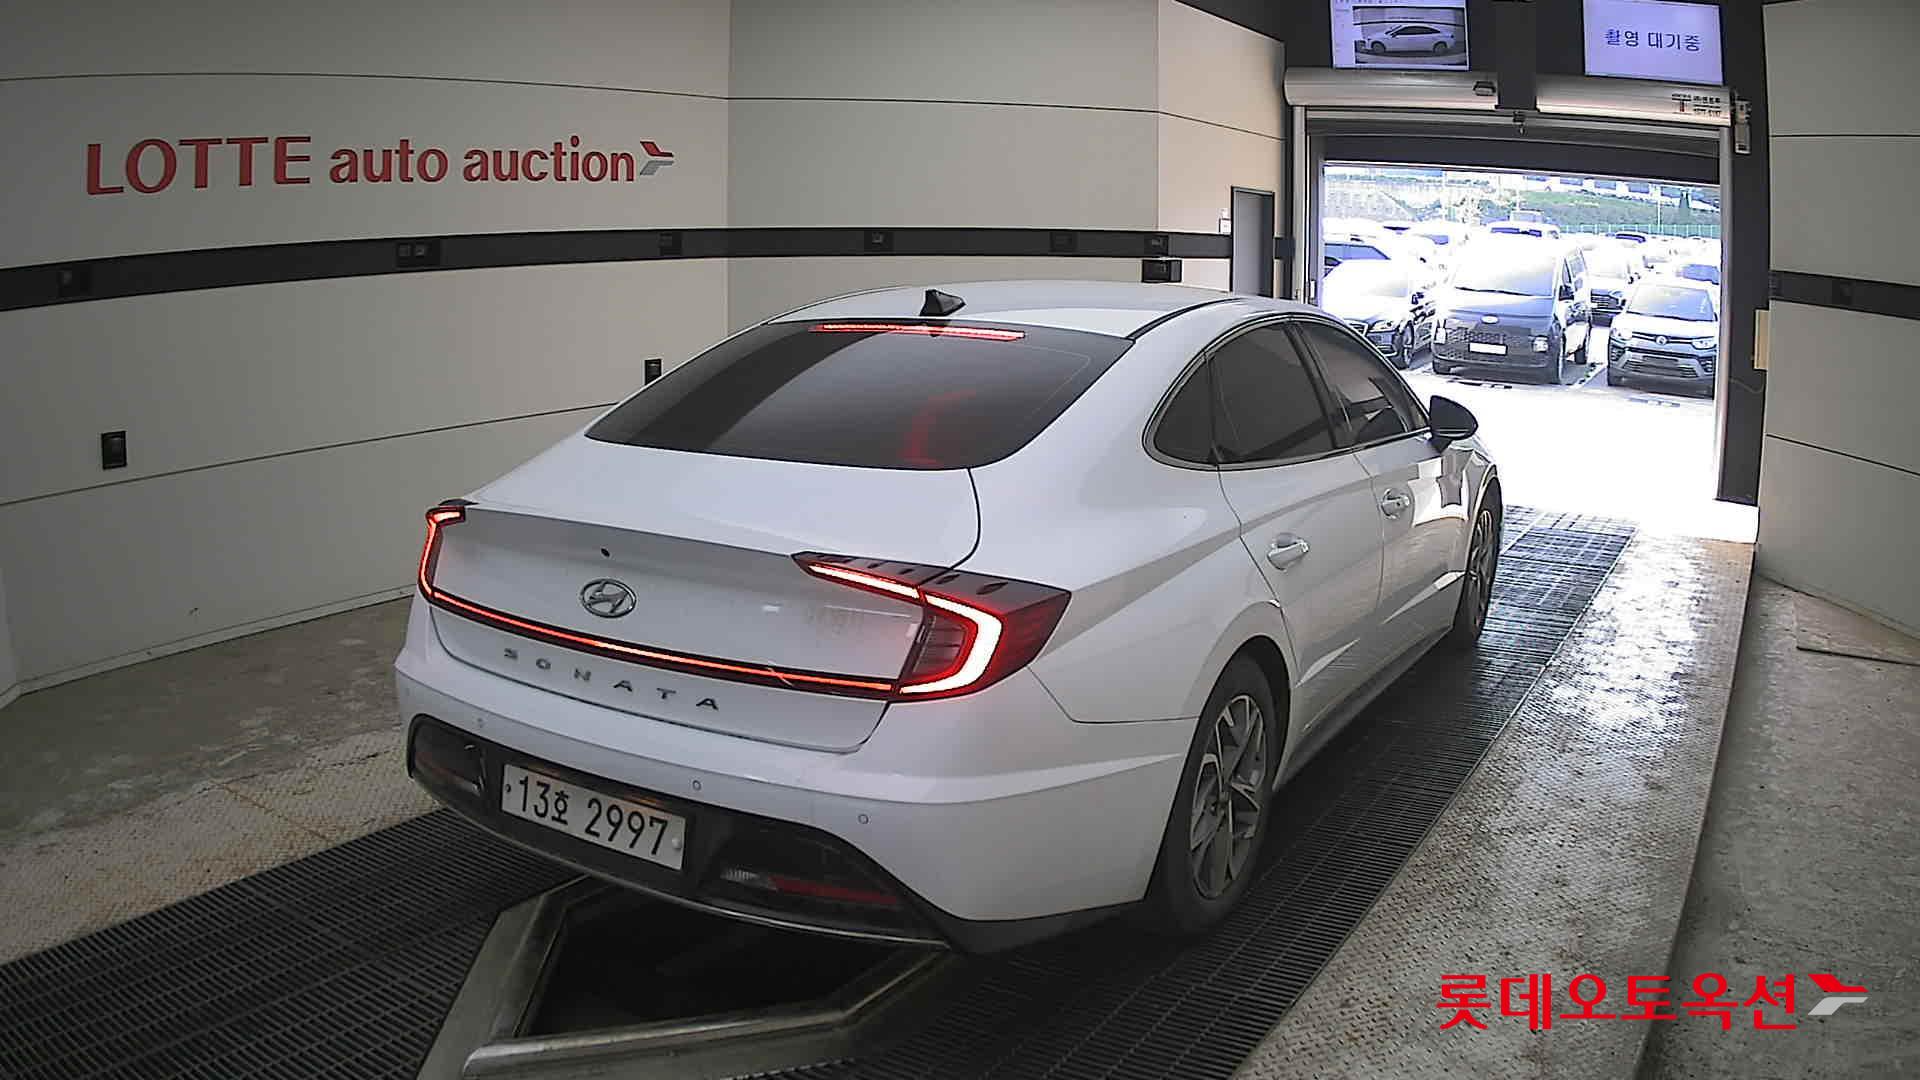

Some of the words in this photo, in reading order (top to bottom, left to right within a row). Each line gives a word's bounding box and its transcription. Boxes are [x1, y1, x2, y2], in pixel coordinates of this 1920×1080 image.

[1603, 28, 1640, 47] 촬영
[1647, 31, 1702, 52] 대기중
[86, 135, 312, 195] LOTTE
[328, 138, 449, 184] auto
[462, 135, 635, 183] auction
[503, 647, 720, 711] SONATA
[519, 775, 570, 826] 13호
[584, 797, 669, 856] 2997
